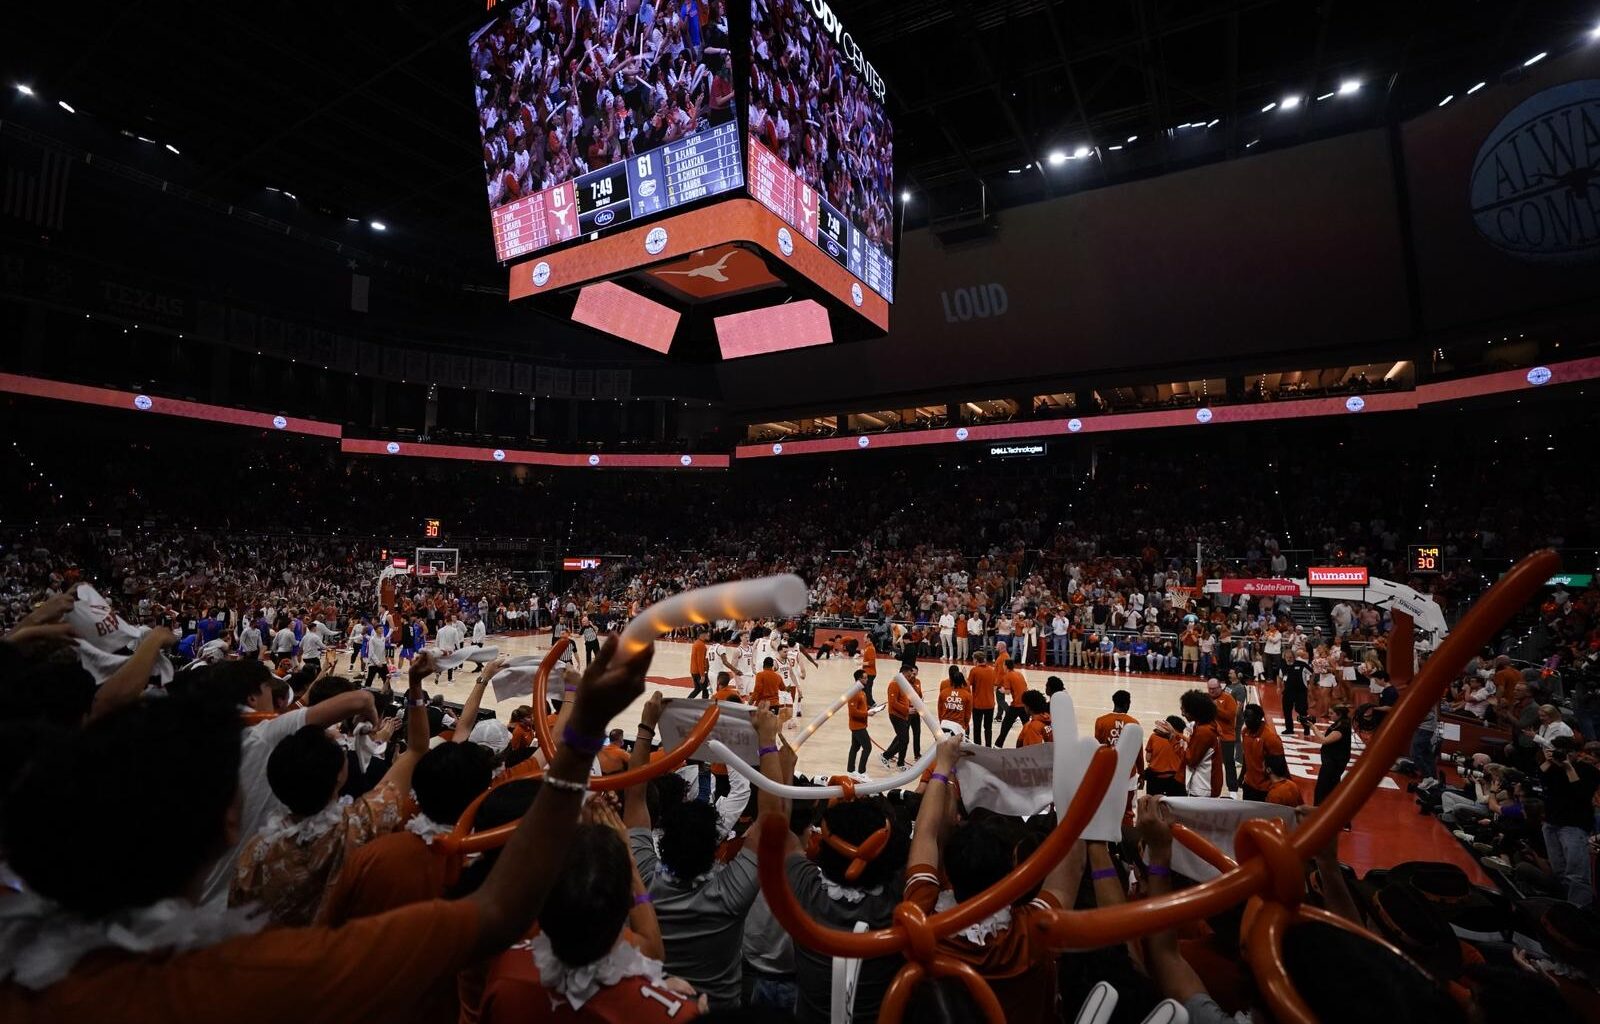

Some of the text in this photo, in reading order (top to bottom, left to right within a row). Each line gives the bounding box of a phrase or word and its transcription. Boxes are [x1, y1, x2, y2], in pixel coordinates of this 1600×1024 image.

[805, 0, 885, 104] ODY CENTER
[1496, 104, 1600, 200] ALWA
[636, 153, 653, 178] 61
[590, 177, 613, 200] 7:49
[552, 186, 566, 208] 61
[802, 183, 812, 207] 61
[597, 213, 612, 223] ufcu
[941, 283, 1009, 323] LOUD
[991, 446, 1043, 455] DELL Technologies
[426, 525, 438, 537] 30
[1418, 548, 1439, 557] 7:49
[1418, 557, 1435, 569] 30
[1311, 571, 1363, 581] humann
[783, 671, 789, 680] 5
[946, 696, 963, 704] OUR
[944, 702, 964, 712] VEINS
[1115, 720, 1124, 728] IN
